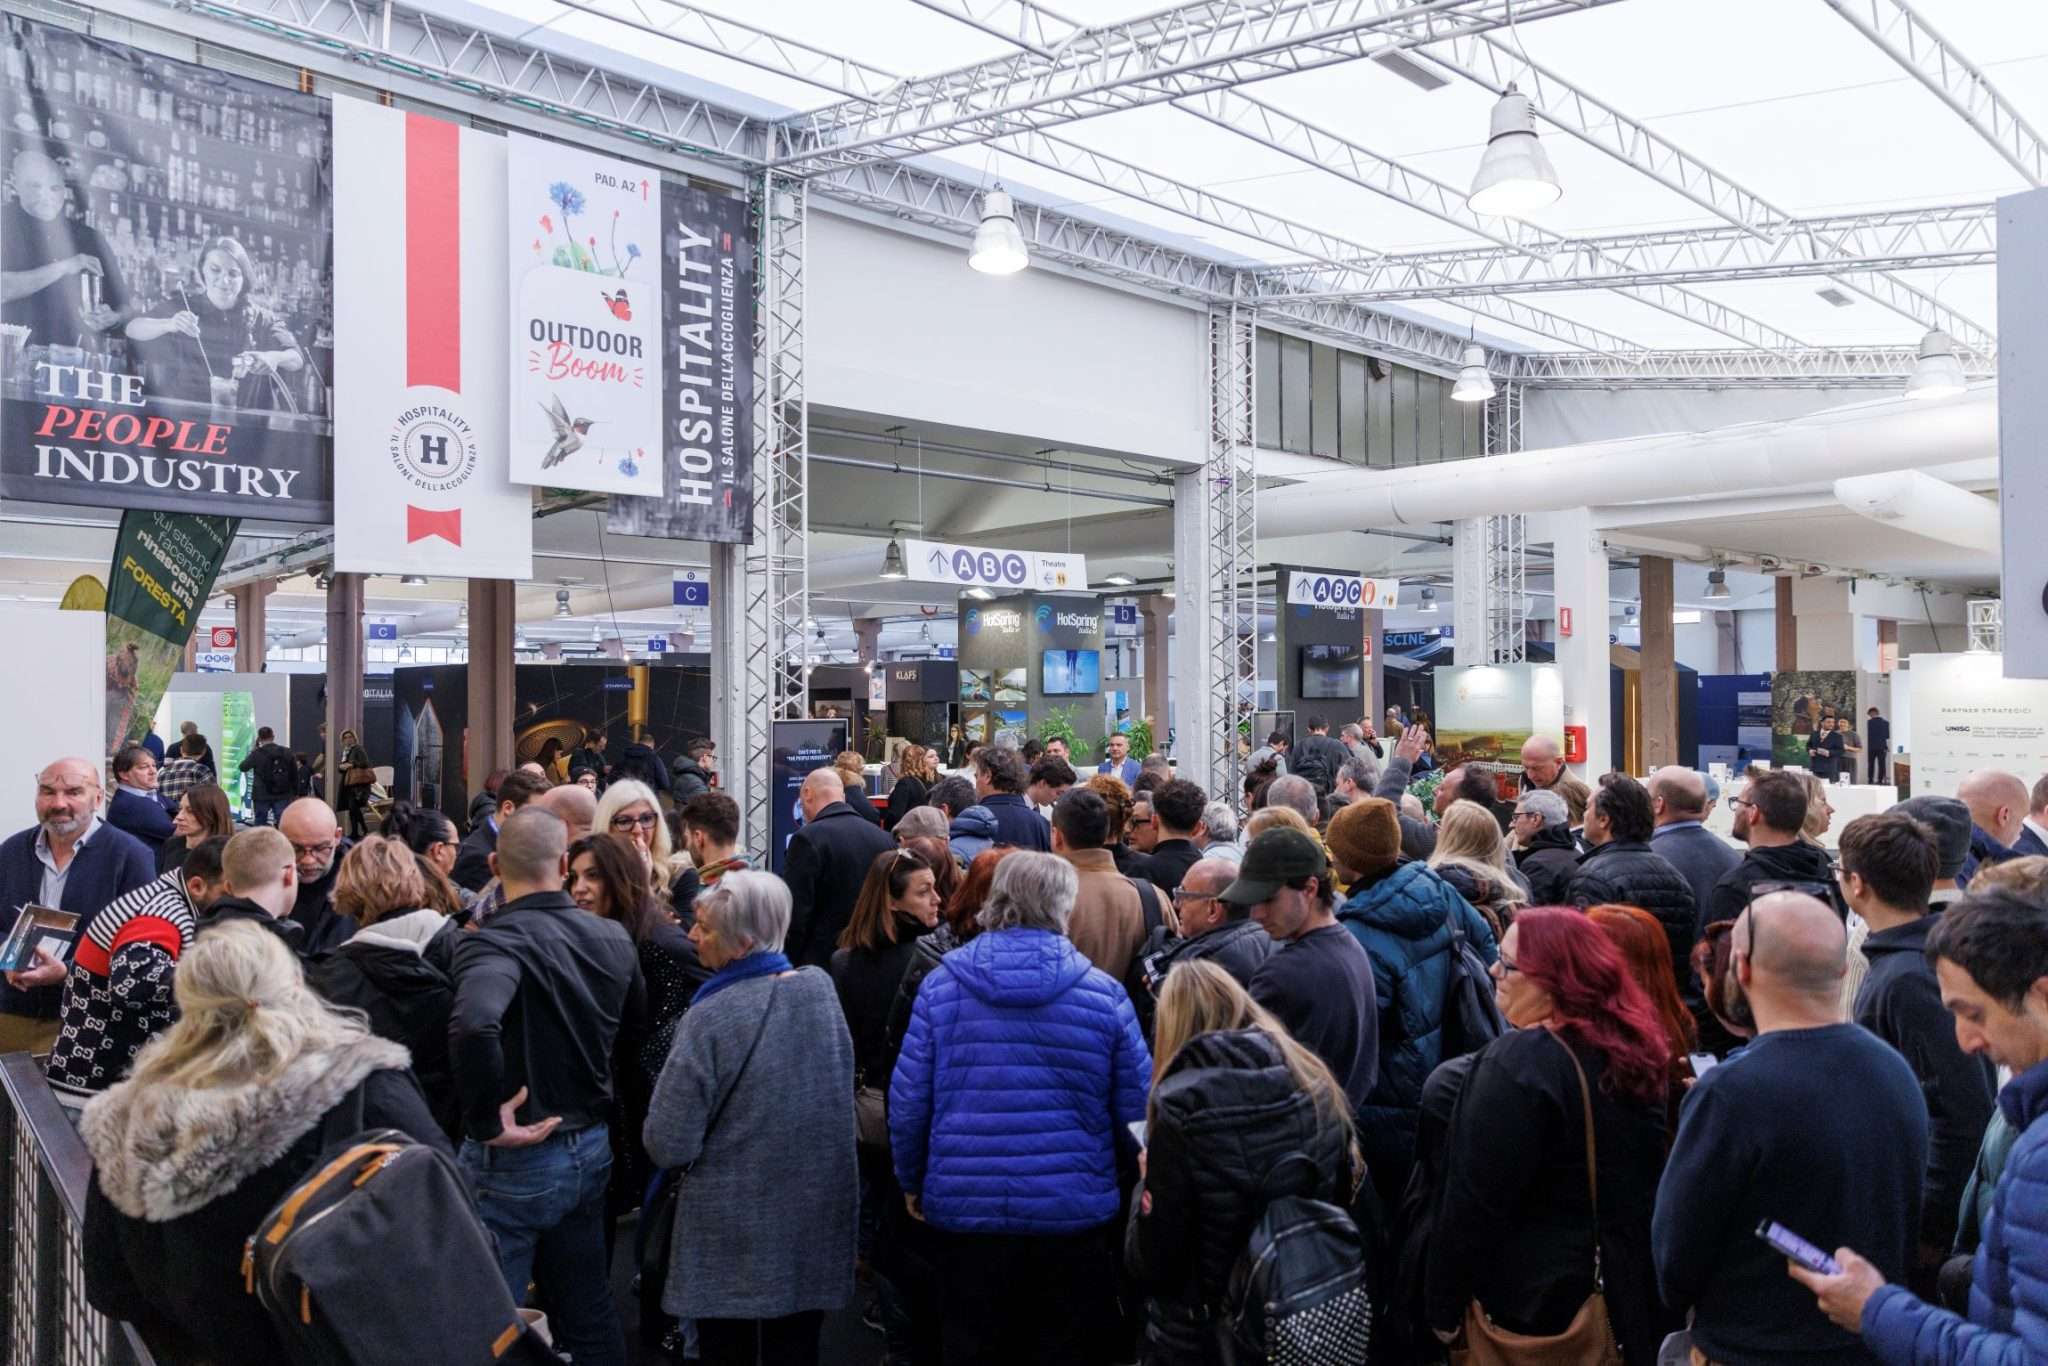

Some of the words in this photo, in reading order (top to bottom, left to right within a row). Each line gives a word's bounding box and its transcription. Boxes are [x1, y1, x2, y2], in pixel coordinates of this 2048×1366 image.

[594, 172, 618, 189] PAD.
[621, 179, 636, 193] A2
[529, 318, 643, 359] OUTDOOR
[721, 257, 734, 402] DELL'ACCOGLIENZA
[546, 341, 629, 383] Boom
[679, 222, 713, 506] HOSPITALITY
[35, 360, 147, 407] THE
[34, 404, 232, 455] PEOPLE
[397, 405, 471, 433] HOSPITALITY
[420, 434, 448, 465] H
[721, 406, 734, 466] SALONE
[34, 444, 300, 499] INDUSTRY
[390, 446, 414, 481] SALONE
[721, 471, 734, 485] IL
[136, 530, 199, 597] rinascere
[158, 531, 205, 585] facendo
[171, 528, 212, 573] stiamo
[1041, 559, 1067, 568] Theatre
[957, 554, 973, 577] A
[982, 556, 997, 577] B
[1006, 558, 1022, 580] C
[123, 555, 187, 626] FORESTA
[171, 581, 194, 610] una
[685, 586, 697, 601] C
[1316, 581, 1327, 599] A
[1334, 581, 1344, 599] B
[1349, 583, 1360, 600] C
[983, 612, 1020, 628] HotSpring
[1056, 611, 1098, 630] HotSpring
[1121, 605, 1129, 621] b
[378, 627, 388, 638] C
[1384, 633, 1426, 647] SCINE
